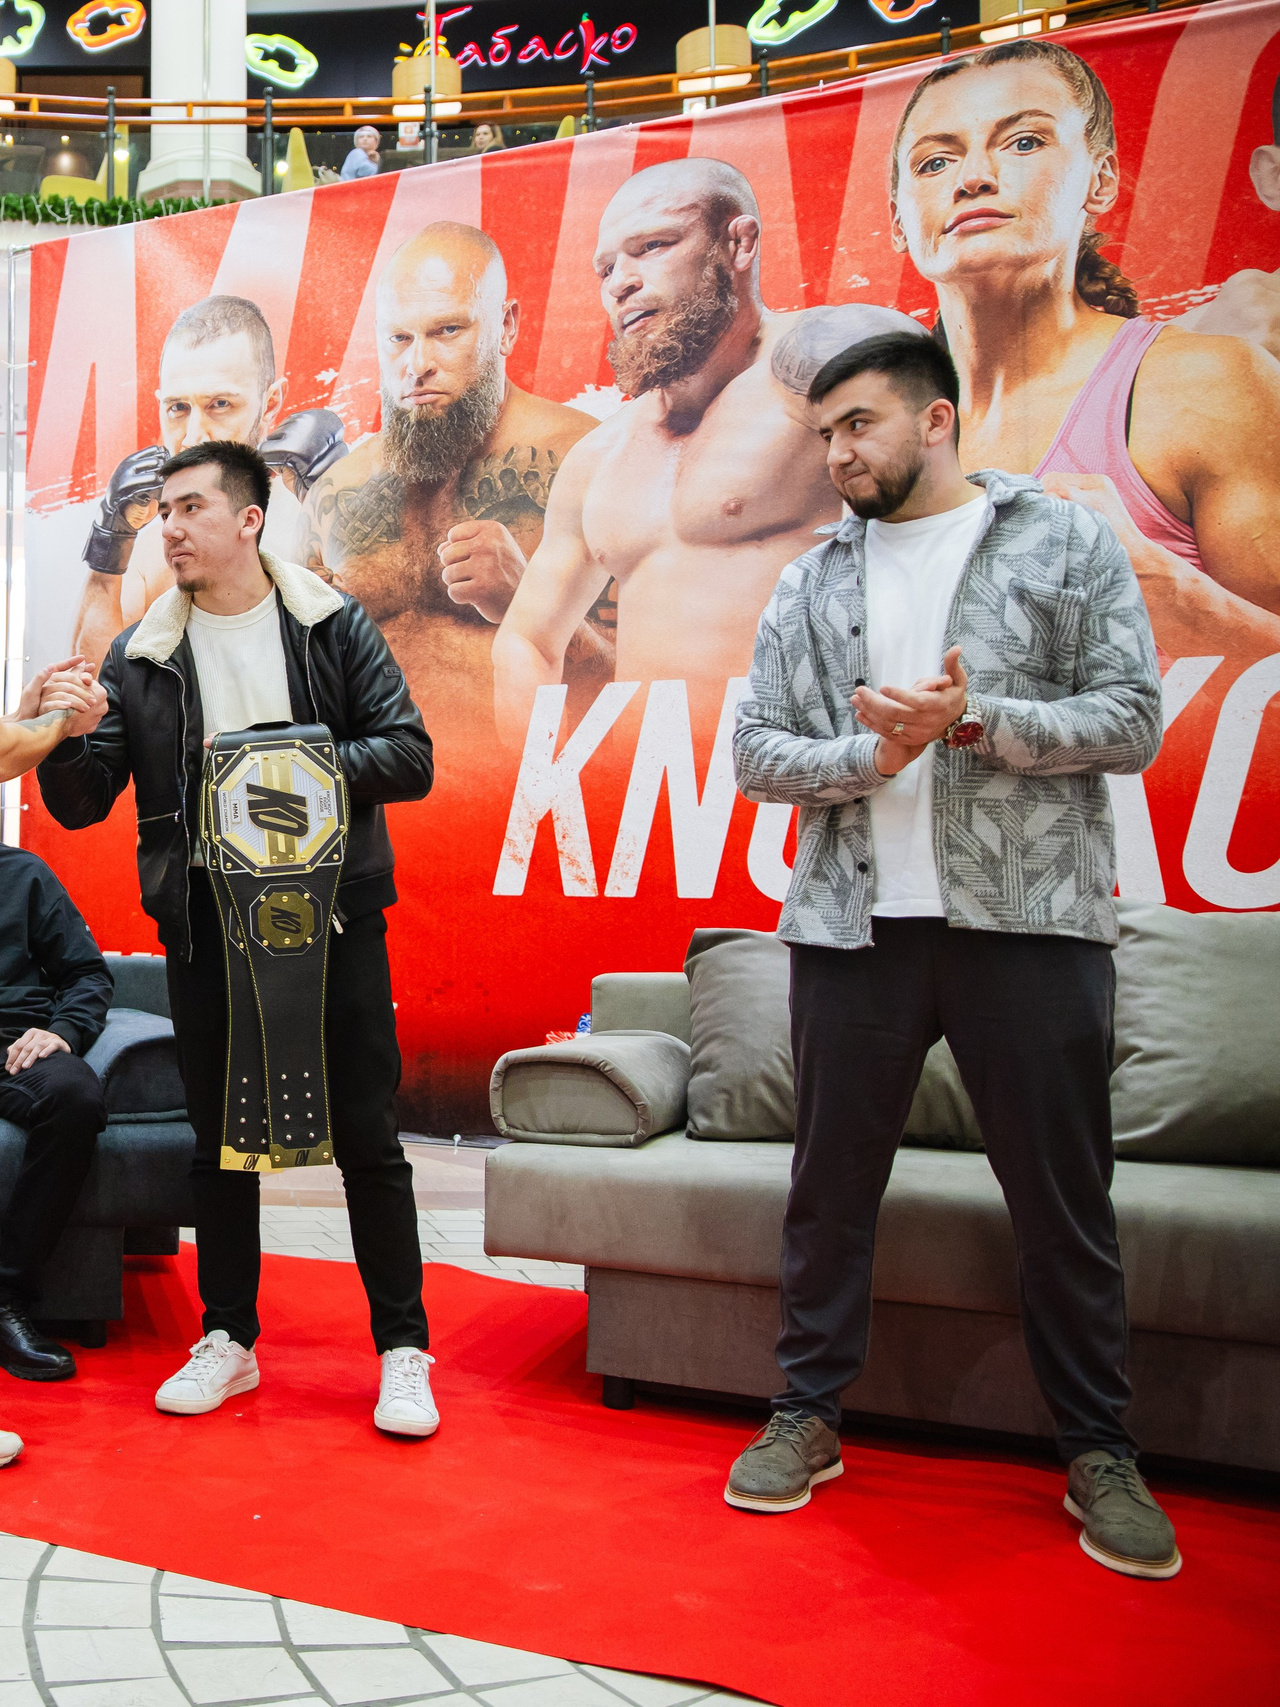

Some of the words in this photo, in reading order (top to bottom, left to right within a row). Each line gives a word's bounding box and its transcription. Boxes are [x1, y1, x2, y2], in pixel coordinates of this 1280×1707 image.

[416, 5, 638, 74] Табаско
[246, 783, 309, 838] KO
[270, 906, 302, 935] KO
